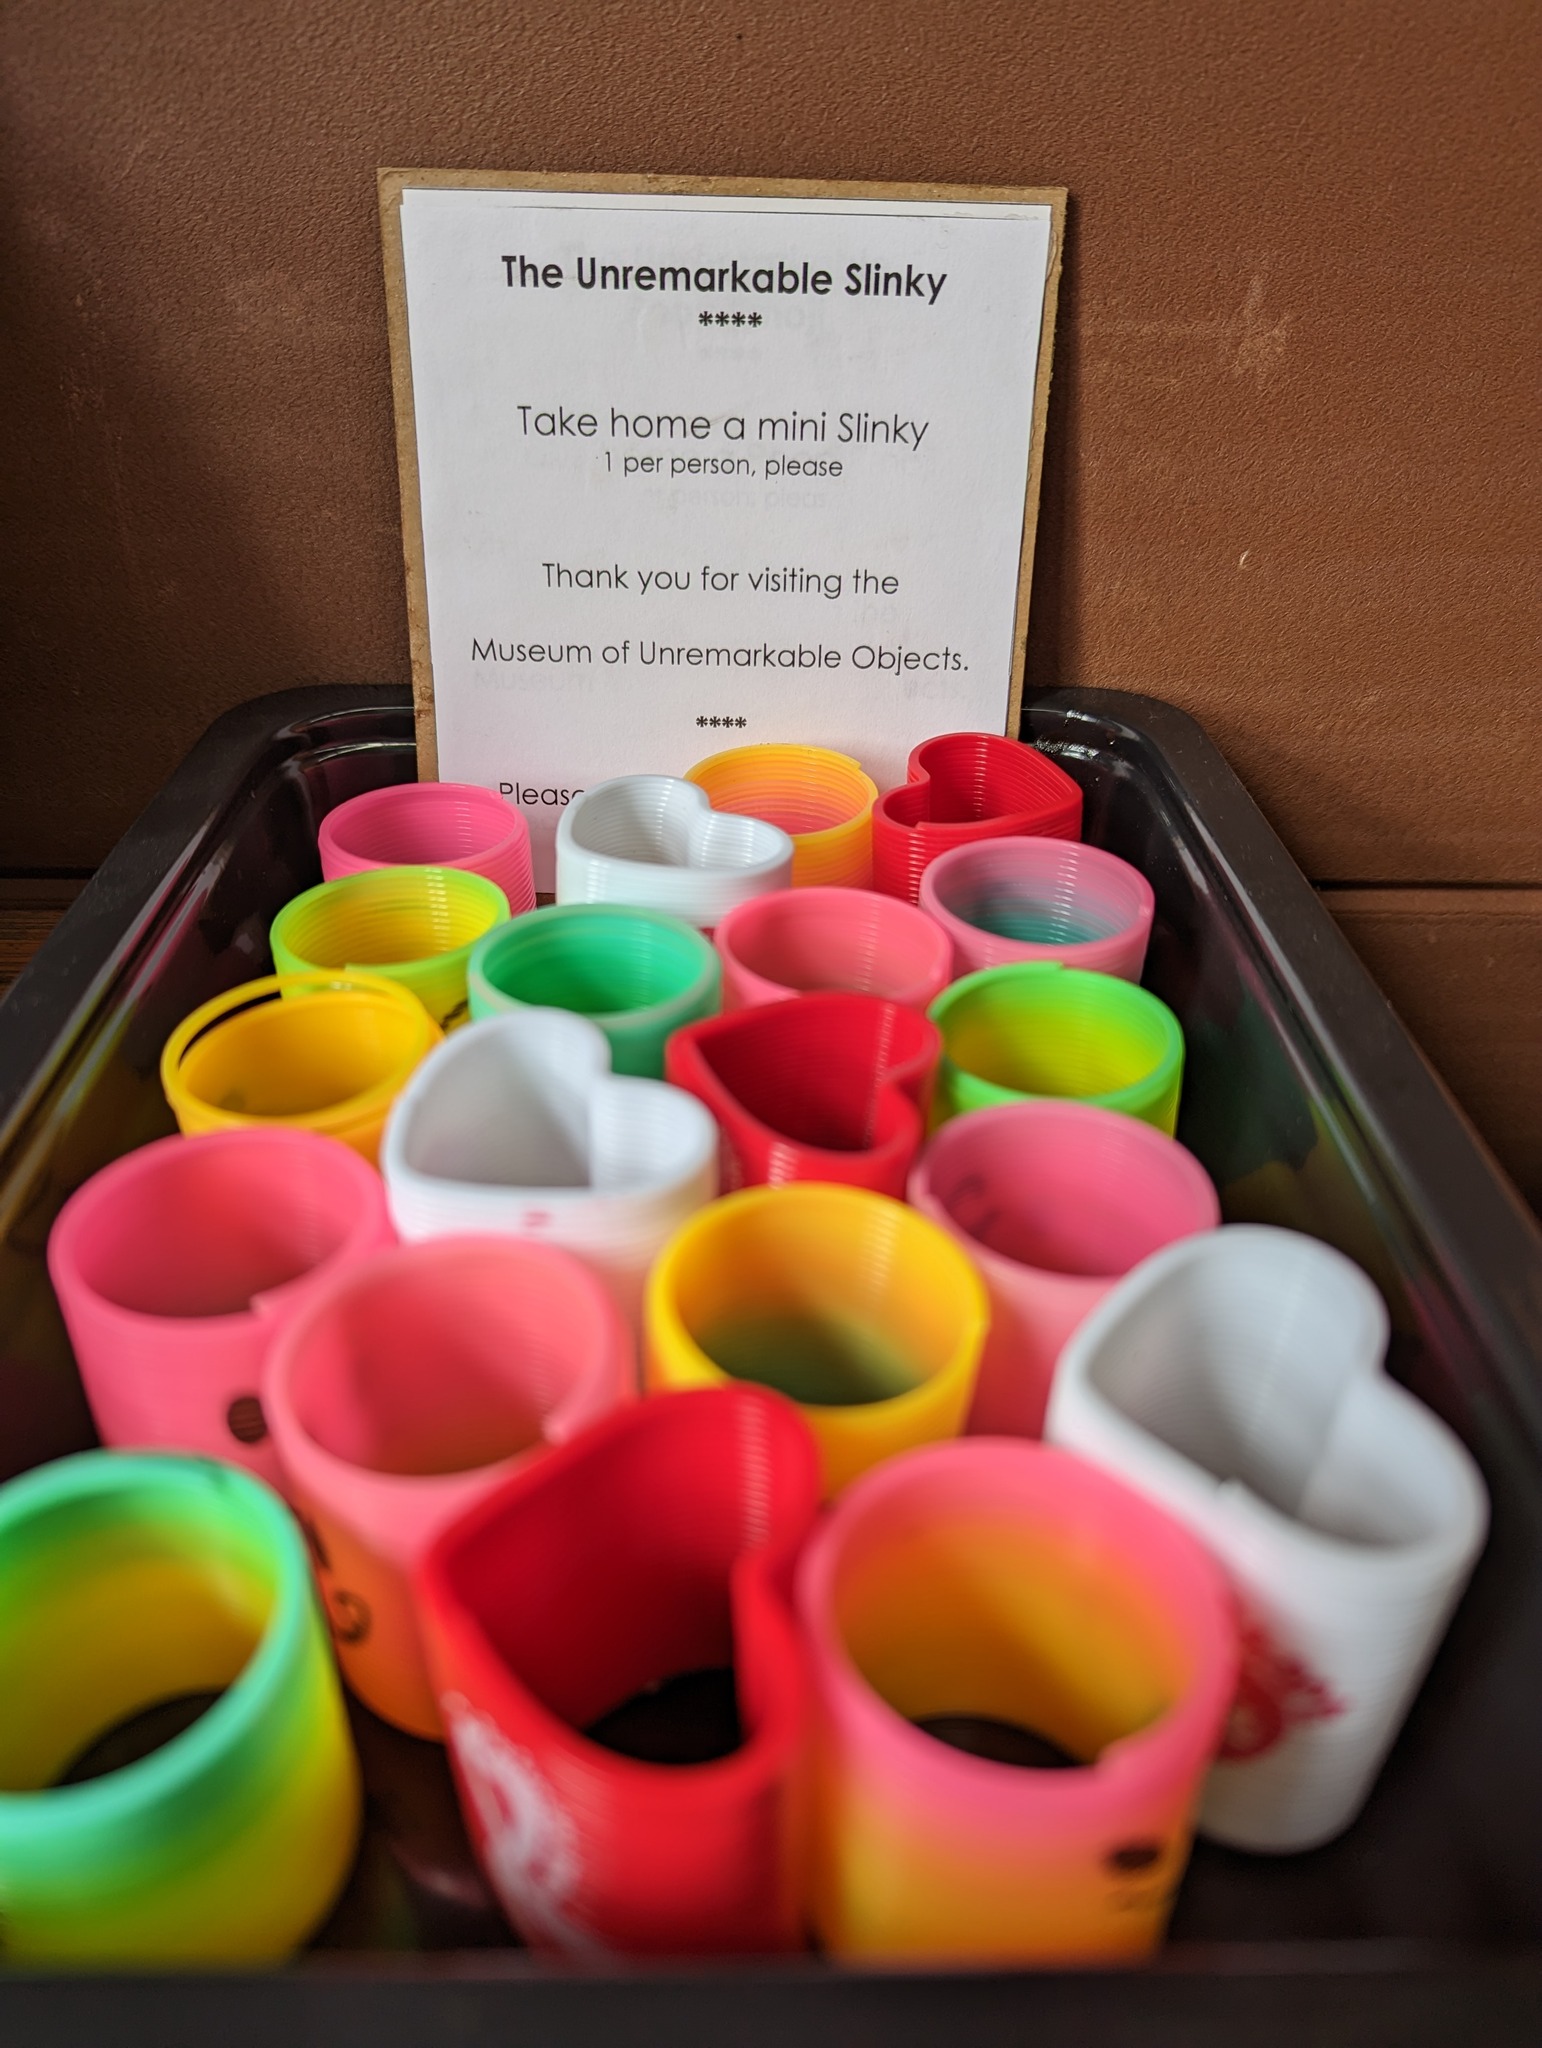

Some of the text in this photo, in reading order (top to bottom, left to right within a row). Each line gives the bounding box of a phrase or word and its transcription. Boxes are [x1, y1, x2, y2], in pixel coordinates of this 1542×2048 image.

[501, 254, 948, 306] The Unremarkable Slinky
[516, 405, 929, 452] Take home a mini Slinky
[605, 451, 843, 480] 1 per person, please
[541, 562, 899, 600] Thank you for visiting the
[471, 638, 969, 676] Museum of Unremarkable Objects.
